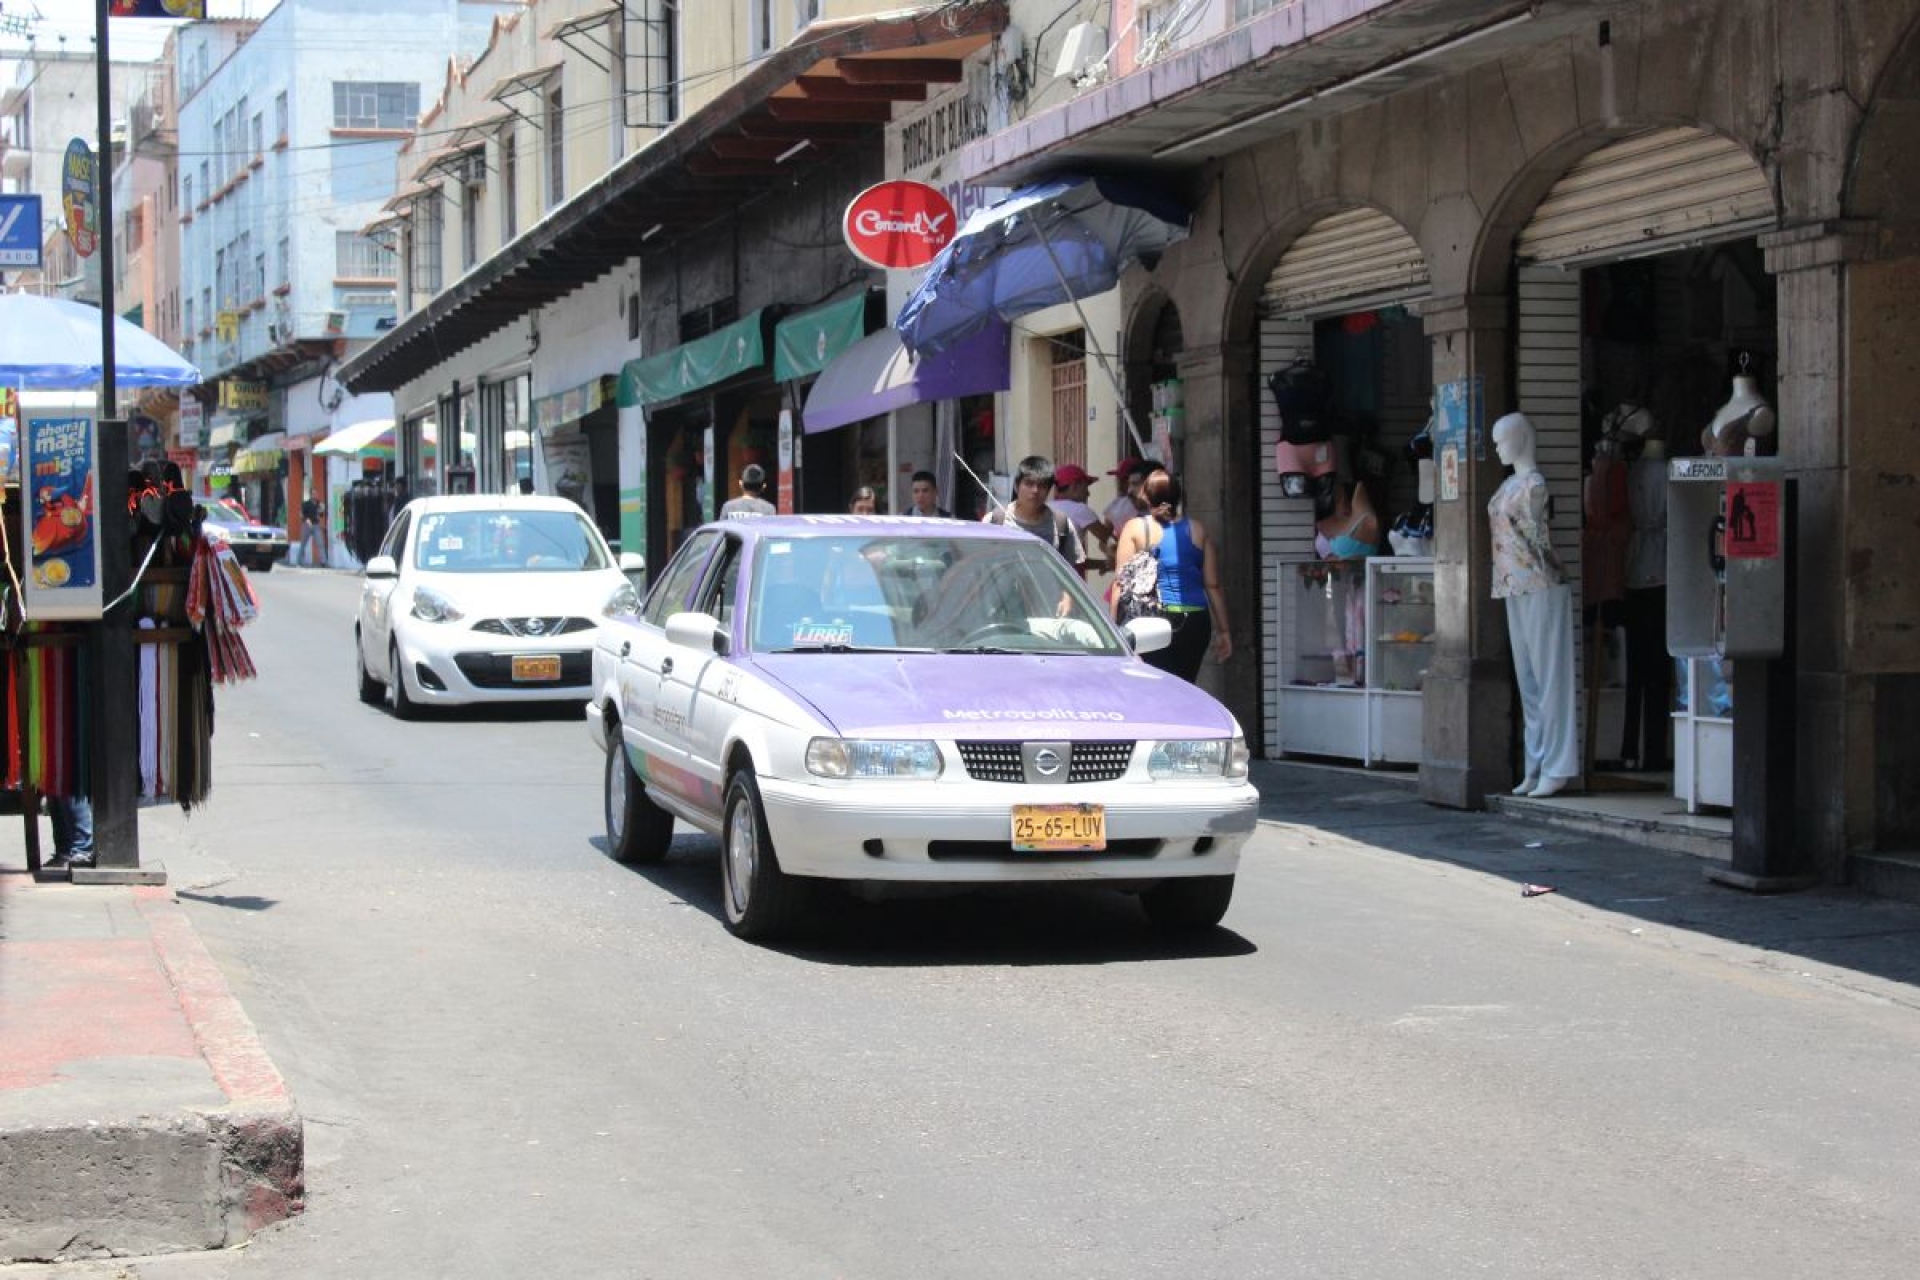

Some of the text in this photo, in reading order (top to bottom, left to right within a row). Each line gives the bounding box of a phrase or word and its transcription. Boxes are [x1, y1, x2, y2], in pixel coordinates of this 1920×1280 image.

[935, 106, 945, 158] DE
[795, 626, 848, 643] LIBRE
[943, 709, 1125, 721] Metropolitano
[1015, 817, 1101, 838] 25-65-LUV
